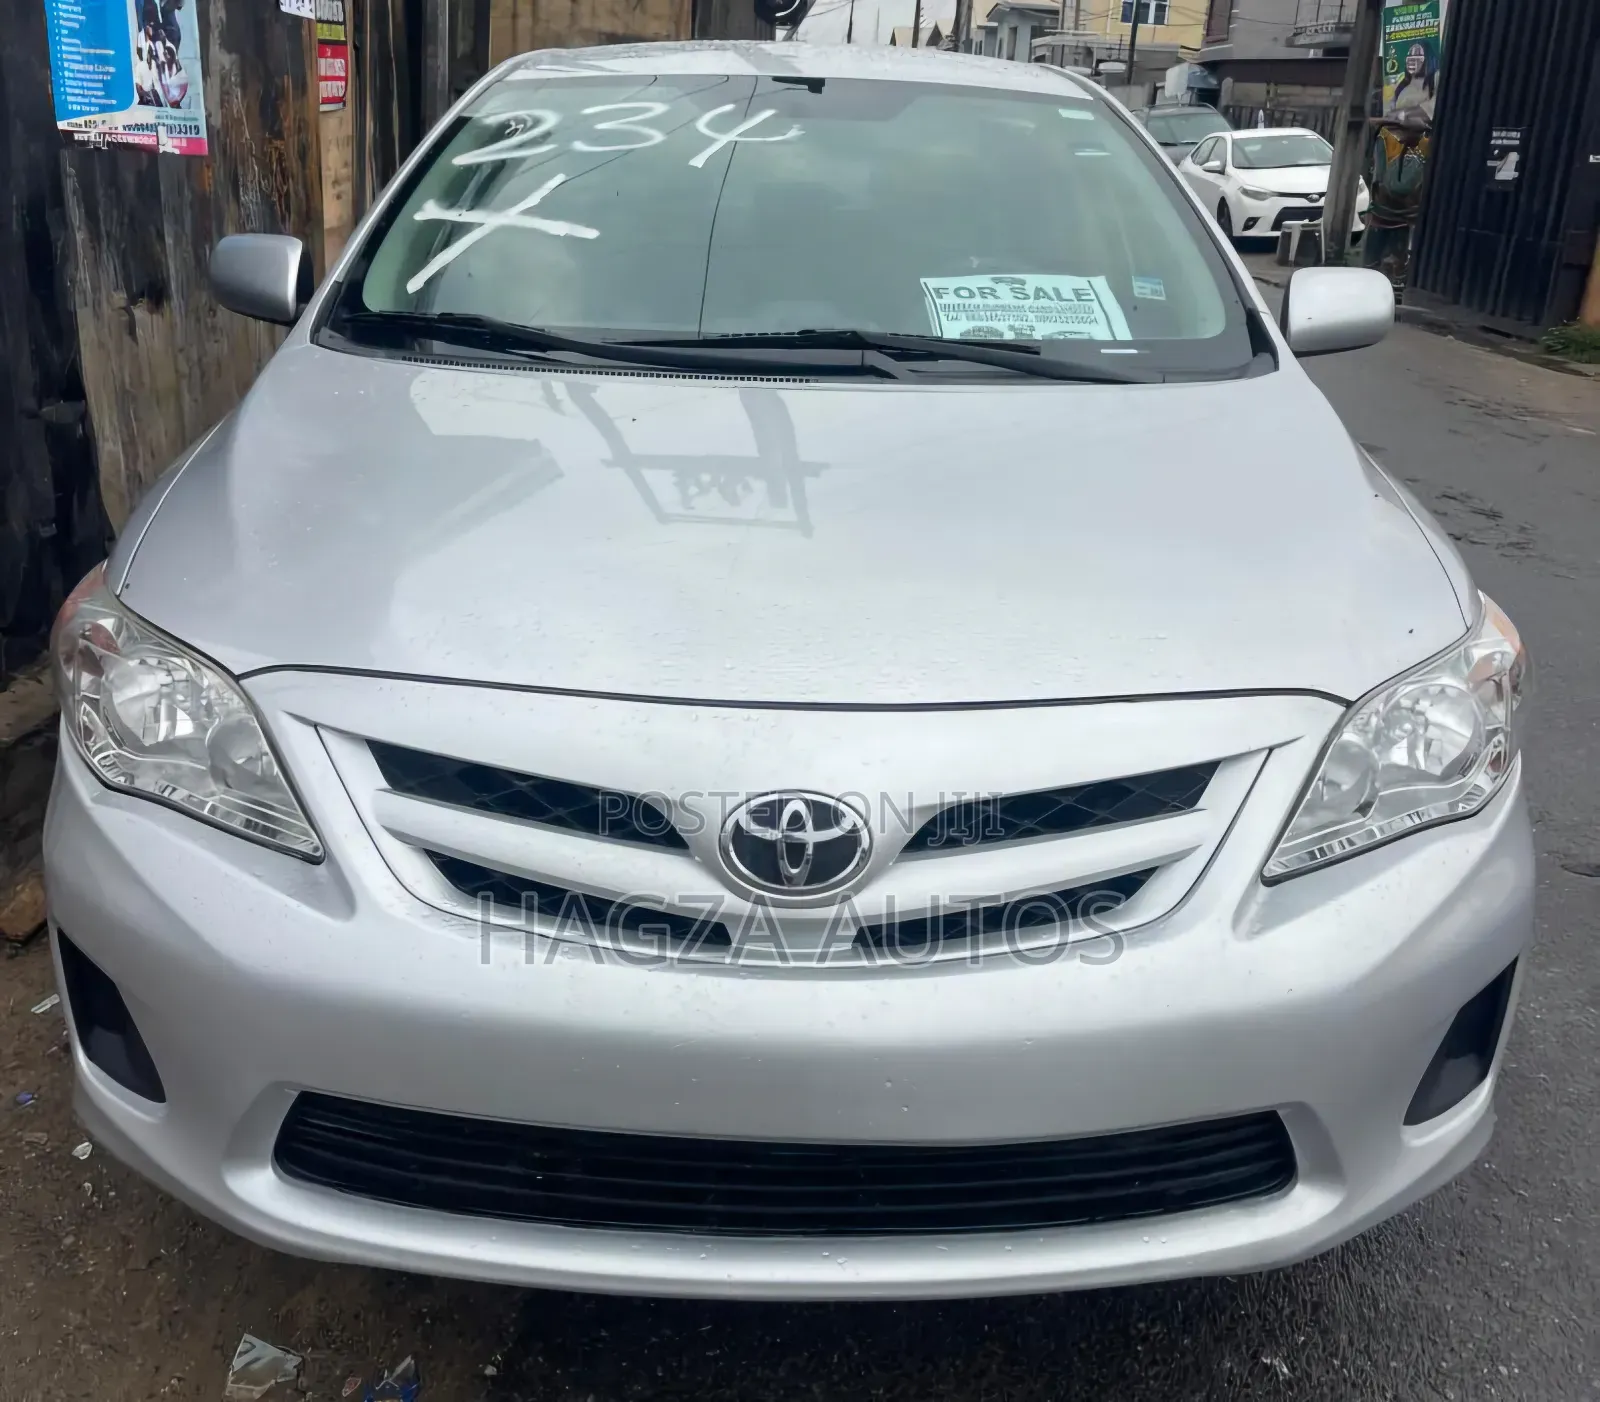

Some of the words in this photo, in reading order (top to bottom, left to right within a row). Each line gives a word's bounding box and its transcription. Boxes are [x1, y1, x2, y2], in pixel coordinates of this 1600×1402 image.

[452, 101, 806, 168] 234
[932, 286, 1001, 300] FOR
[1009, 286, 1096, 302] SALE
